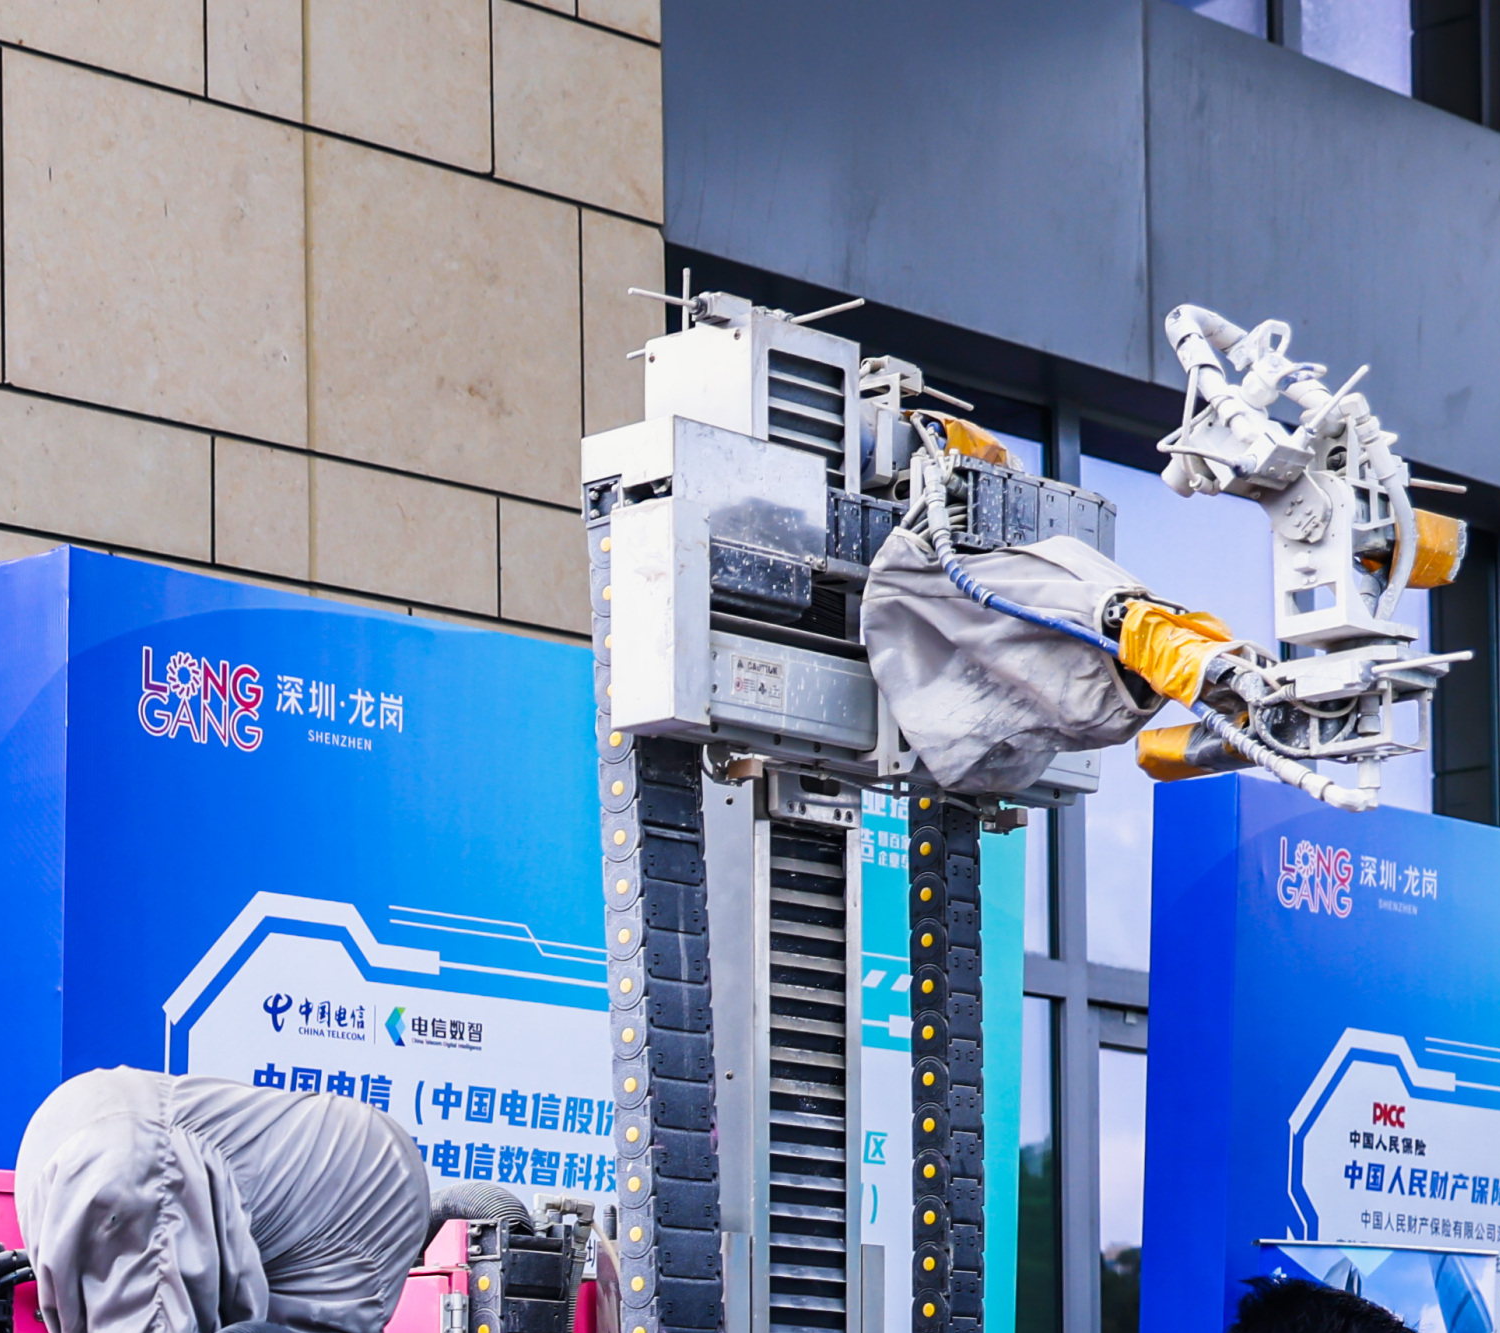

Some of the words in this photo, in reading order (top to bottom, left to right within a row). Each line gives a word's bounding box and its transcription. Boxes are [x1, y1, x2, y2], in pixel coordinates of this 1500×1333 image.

[142, 646, 263, 711] LONG
[275, 674, 404, 733] 深圳·龙岗
[138, 694, 263, 752] GANG
[307, 729, 373, 752] SHENZHEN
[1279, 836, 1354, 886] LONG
[1359, 854, 1438, 901] 深圳·龙岗
[1277, 871, 1354, 918] GANG
[298, 997, 366, 1030] 中国电信
[411, 1016, 483, 1043] 电信数智
[298, 1026, 325, 1038] CHINA
[327, 1030, 366, 1042] TELECOM
[1372, 1102, 1406, 1129] PICC
[863, 1130, 888, 1165] 区
[1349, 1130, 1427, 1157] 中国人民保险
